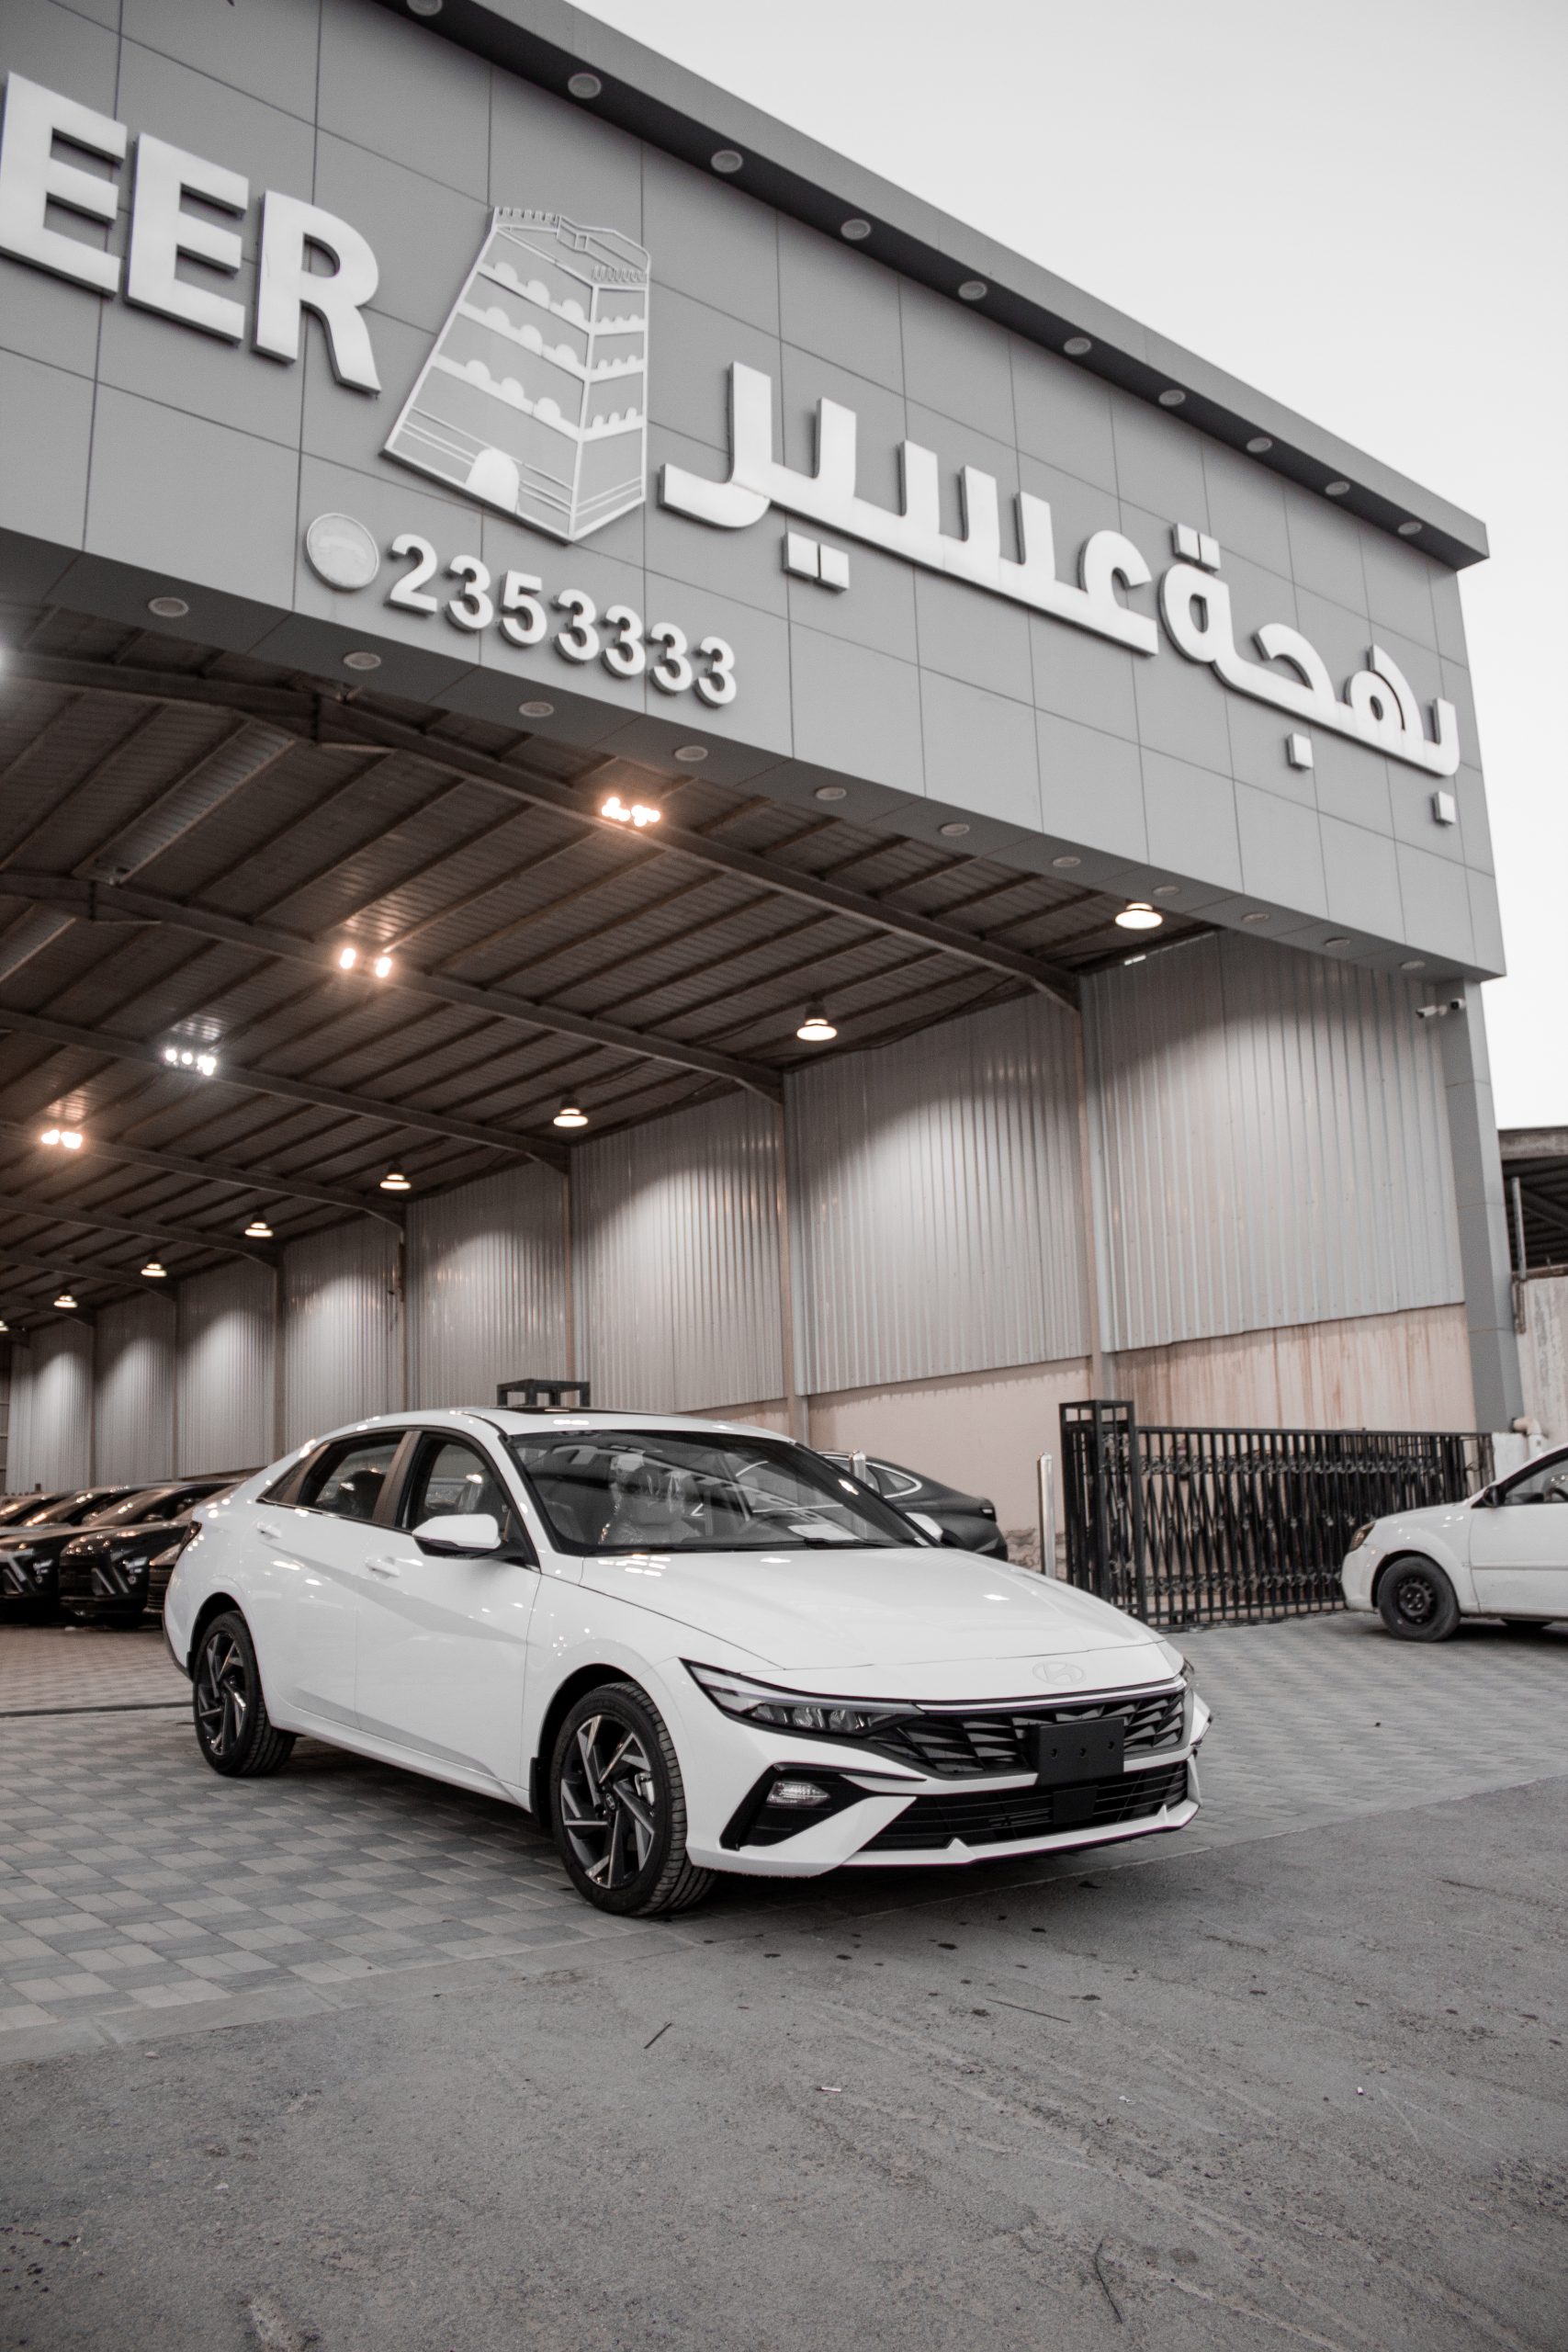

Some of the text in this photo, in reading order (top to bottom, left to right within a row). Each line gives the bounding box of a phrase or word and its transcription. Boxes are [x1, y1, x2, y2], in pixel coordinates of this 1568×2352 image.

[0, 71, 381, 398] EER
[389, 534, 737, 707] 2353333
[659, 361, 1461, 825] بهجة عسير
